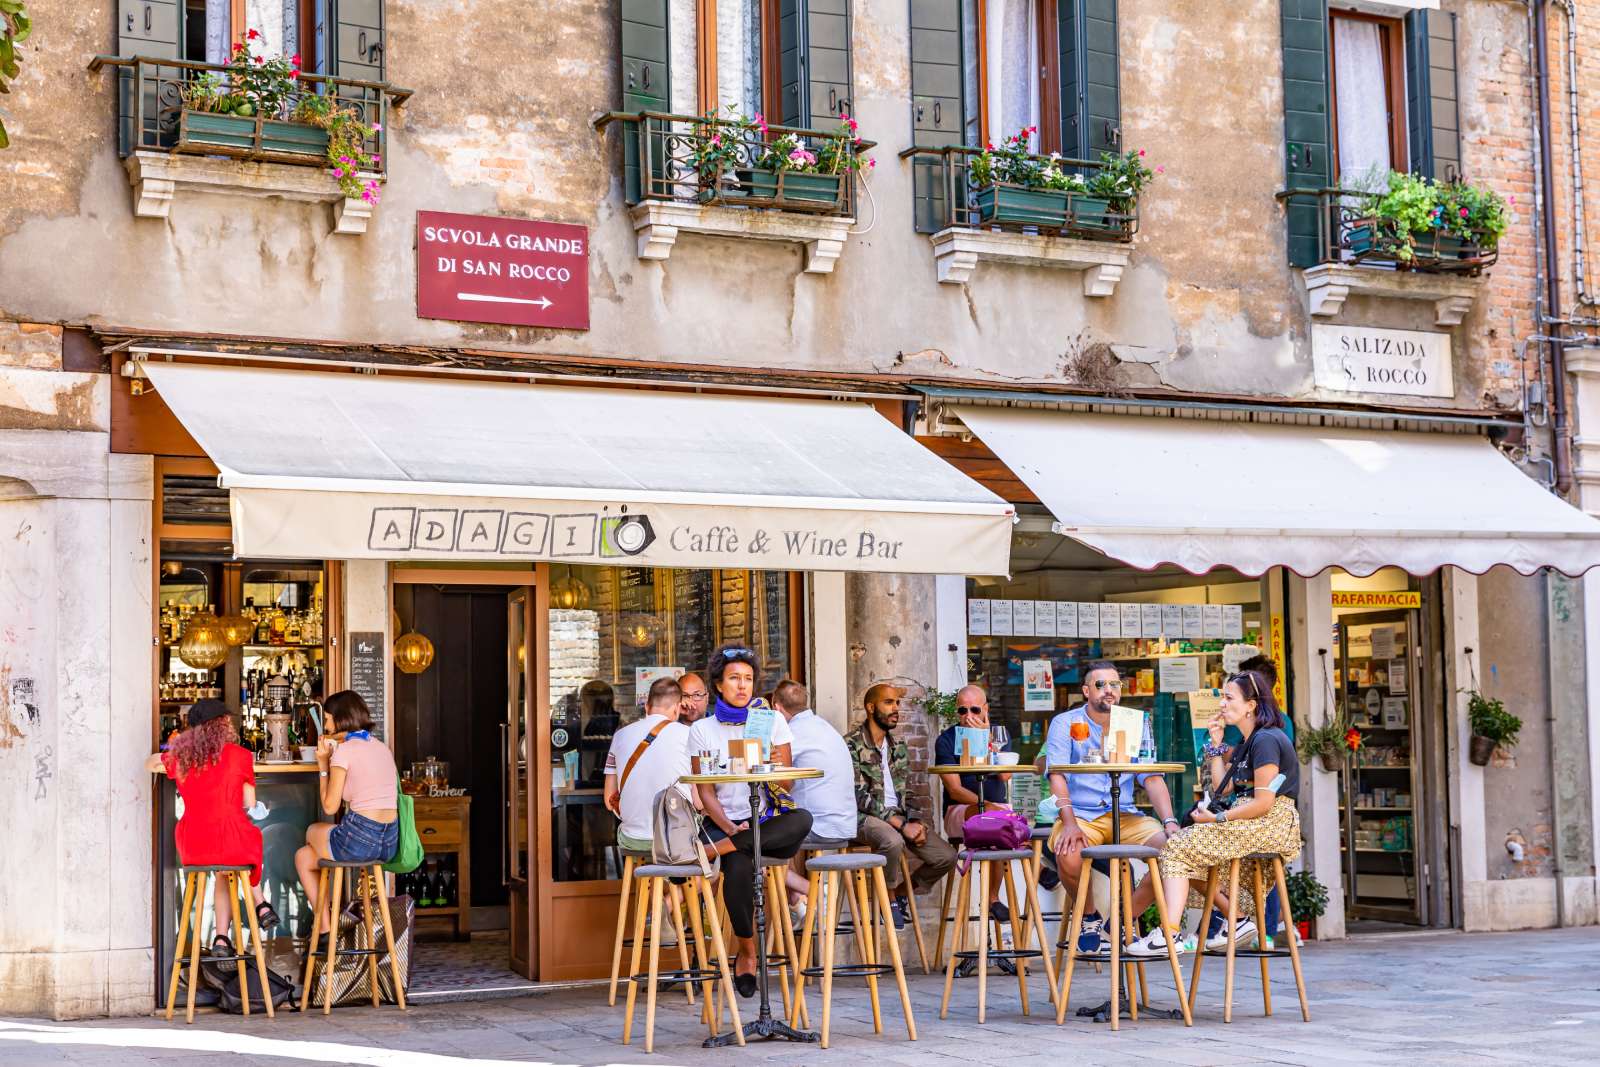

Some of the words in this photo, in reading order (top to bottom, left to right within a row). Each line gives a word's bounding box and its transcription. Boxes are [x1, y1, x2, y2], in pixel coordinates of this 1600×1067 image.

[424, 226, 502, 248] SCVOLA
[505, 234, 583, 255] GRANDE
[437, 257, 457, 273] DI
[462, 259, 501, 276] SAN
[509, 263, 571, 282] ROCCO
[1341, 335, 1426, 358] SALIZADA
[1344, 365, 1356, 381] S.
[1367, 366, 1427, 386] ROCCO
[670, 525, 739, 553] Caffè
[747, 528, 770, 555] &
[782, 530, 848, 557] Wine
[855, 530, 903, 560] Bar
